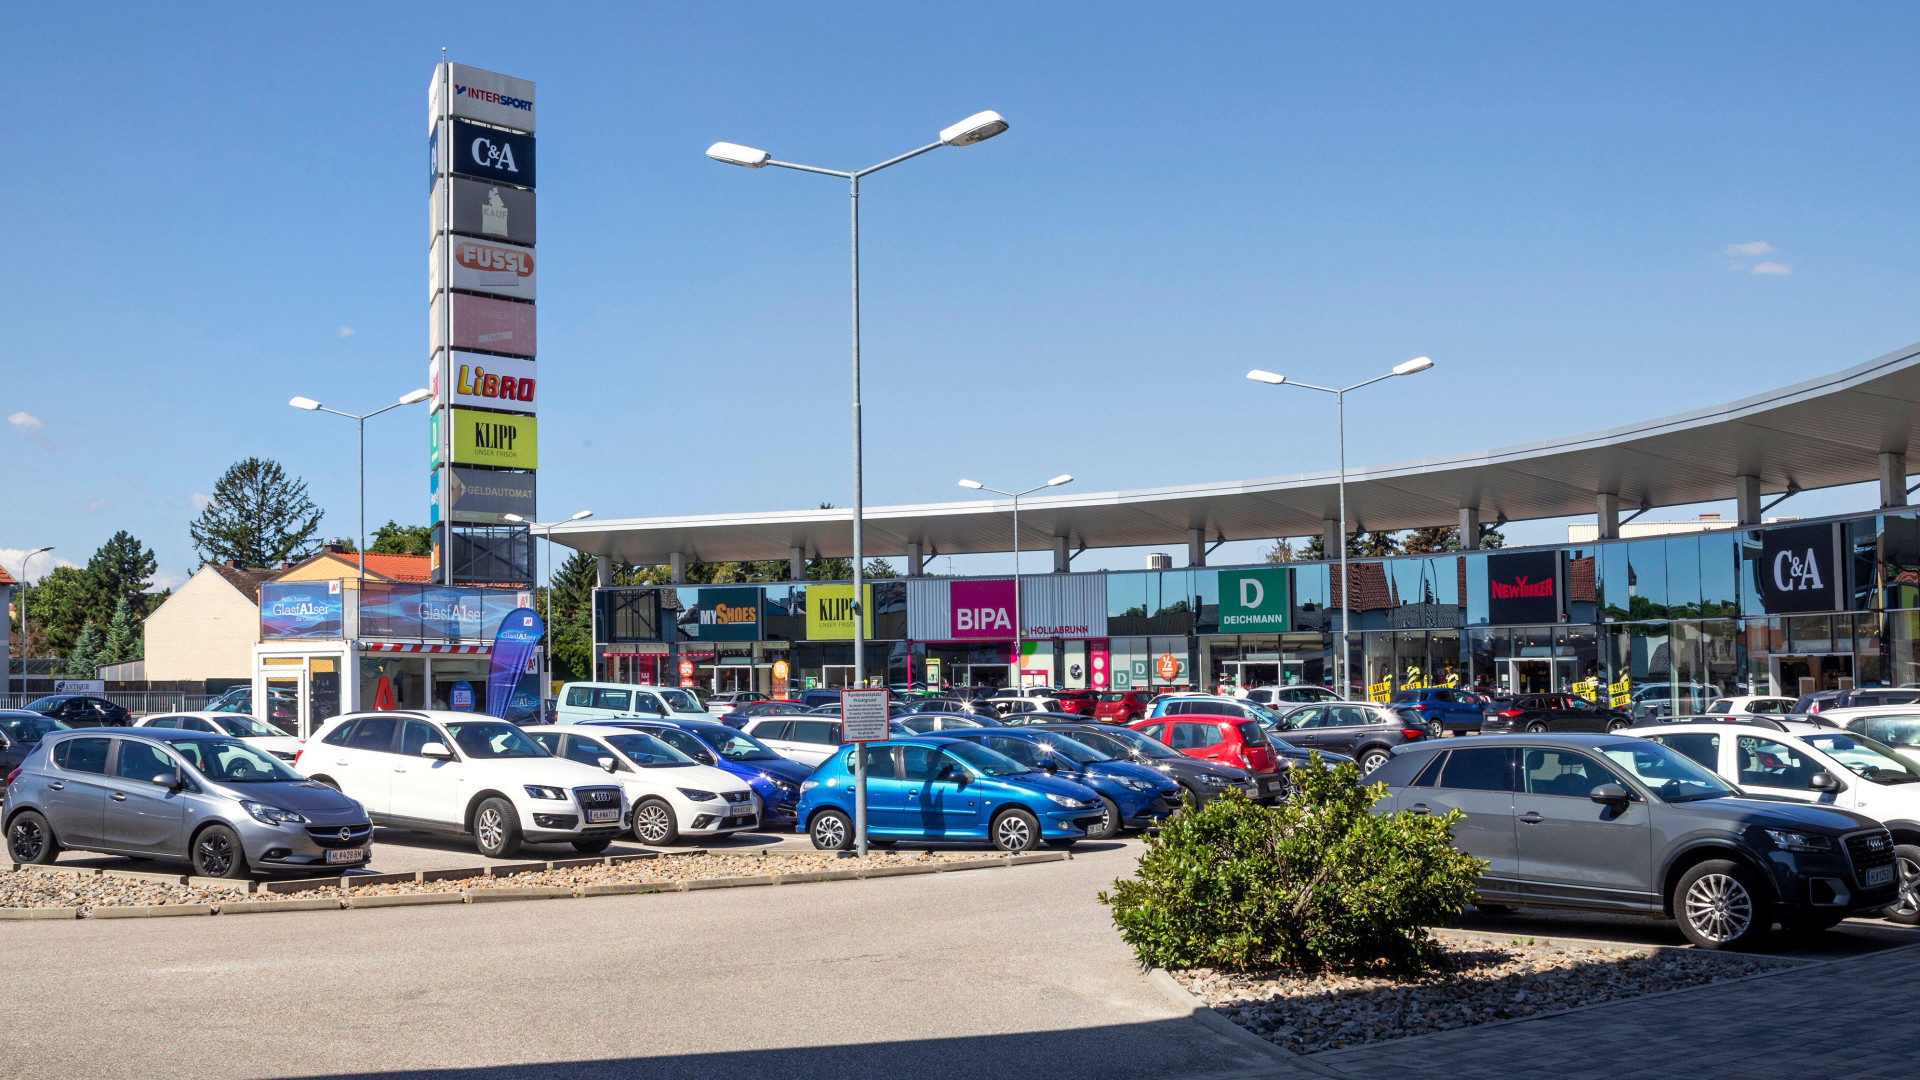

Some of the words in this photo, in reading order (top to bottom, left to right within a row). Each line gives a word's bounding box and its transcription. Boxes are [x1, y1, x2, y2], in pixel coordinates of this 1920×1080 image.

[468, 87, 533, 112] INTERSPORT
[471, 137, 518, 172] C&A
[483, 207, 508, 219] KAUF
[463, 245, 529, 273] FUSSL
[475, 421, 517, 451] KLIPP
[474, 448, 495, 456] UNSER
[467, 485, 533, 498] GELDAUTOMAT
[1773, 547, 1824, 591] C&A
[272, 602, 329, 616] GlasfA1ser
[418, 602, 486, 622] GlasfA1ser
[957, 607, 1012, 630] BIPA
[1223, 613, 1282, 625] DEICHMANN
[1030, 625, 1089, 635] HOLLABRUNN
[1372, 683, 1385, 693] SALE
[1612, 682, 1625, 693] SALE
[1614, 695, 1627, 706] SALE
